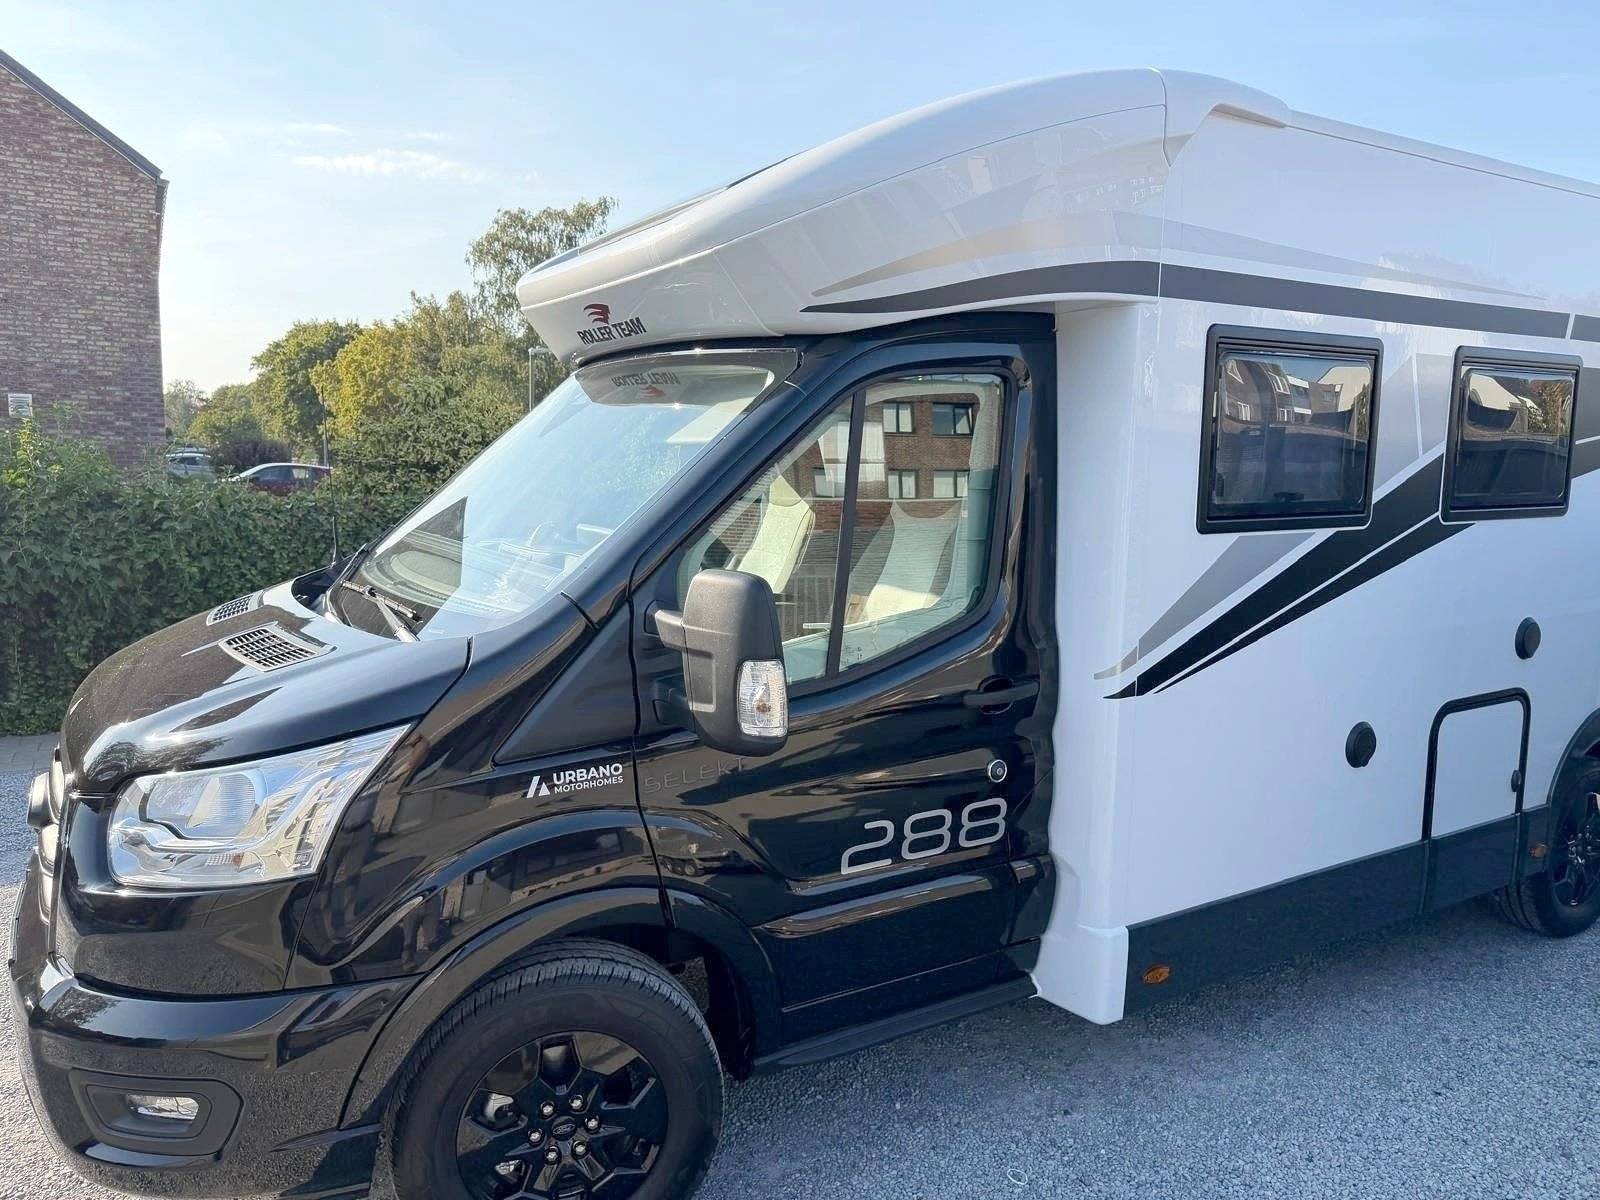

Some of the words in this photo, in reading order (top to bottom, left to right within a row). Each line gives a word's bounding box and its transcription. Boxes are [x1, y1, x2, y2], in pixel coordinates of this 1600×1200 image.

[577, 326, 616, 345] ROLLER
[611, 317, 647, 338] TEAM
[552, 763, 623, 785] URBANO
[554, 775, 624, 794] MOTORHOMES
[841, 798, 1008, 875] 288
